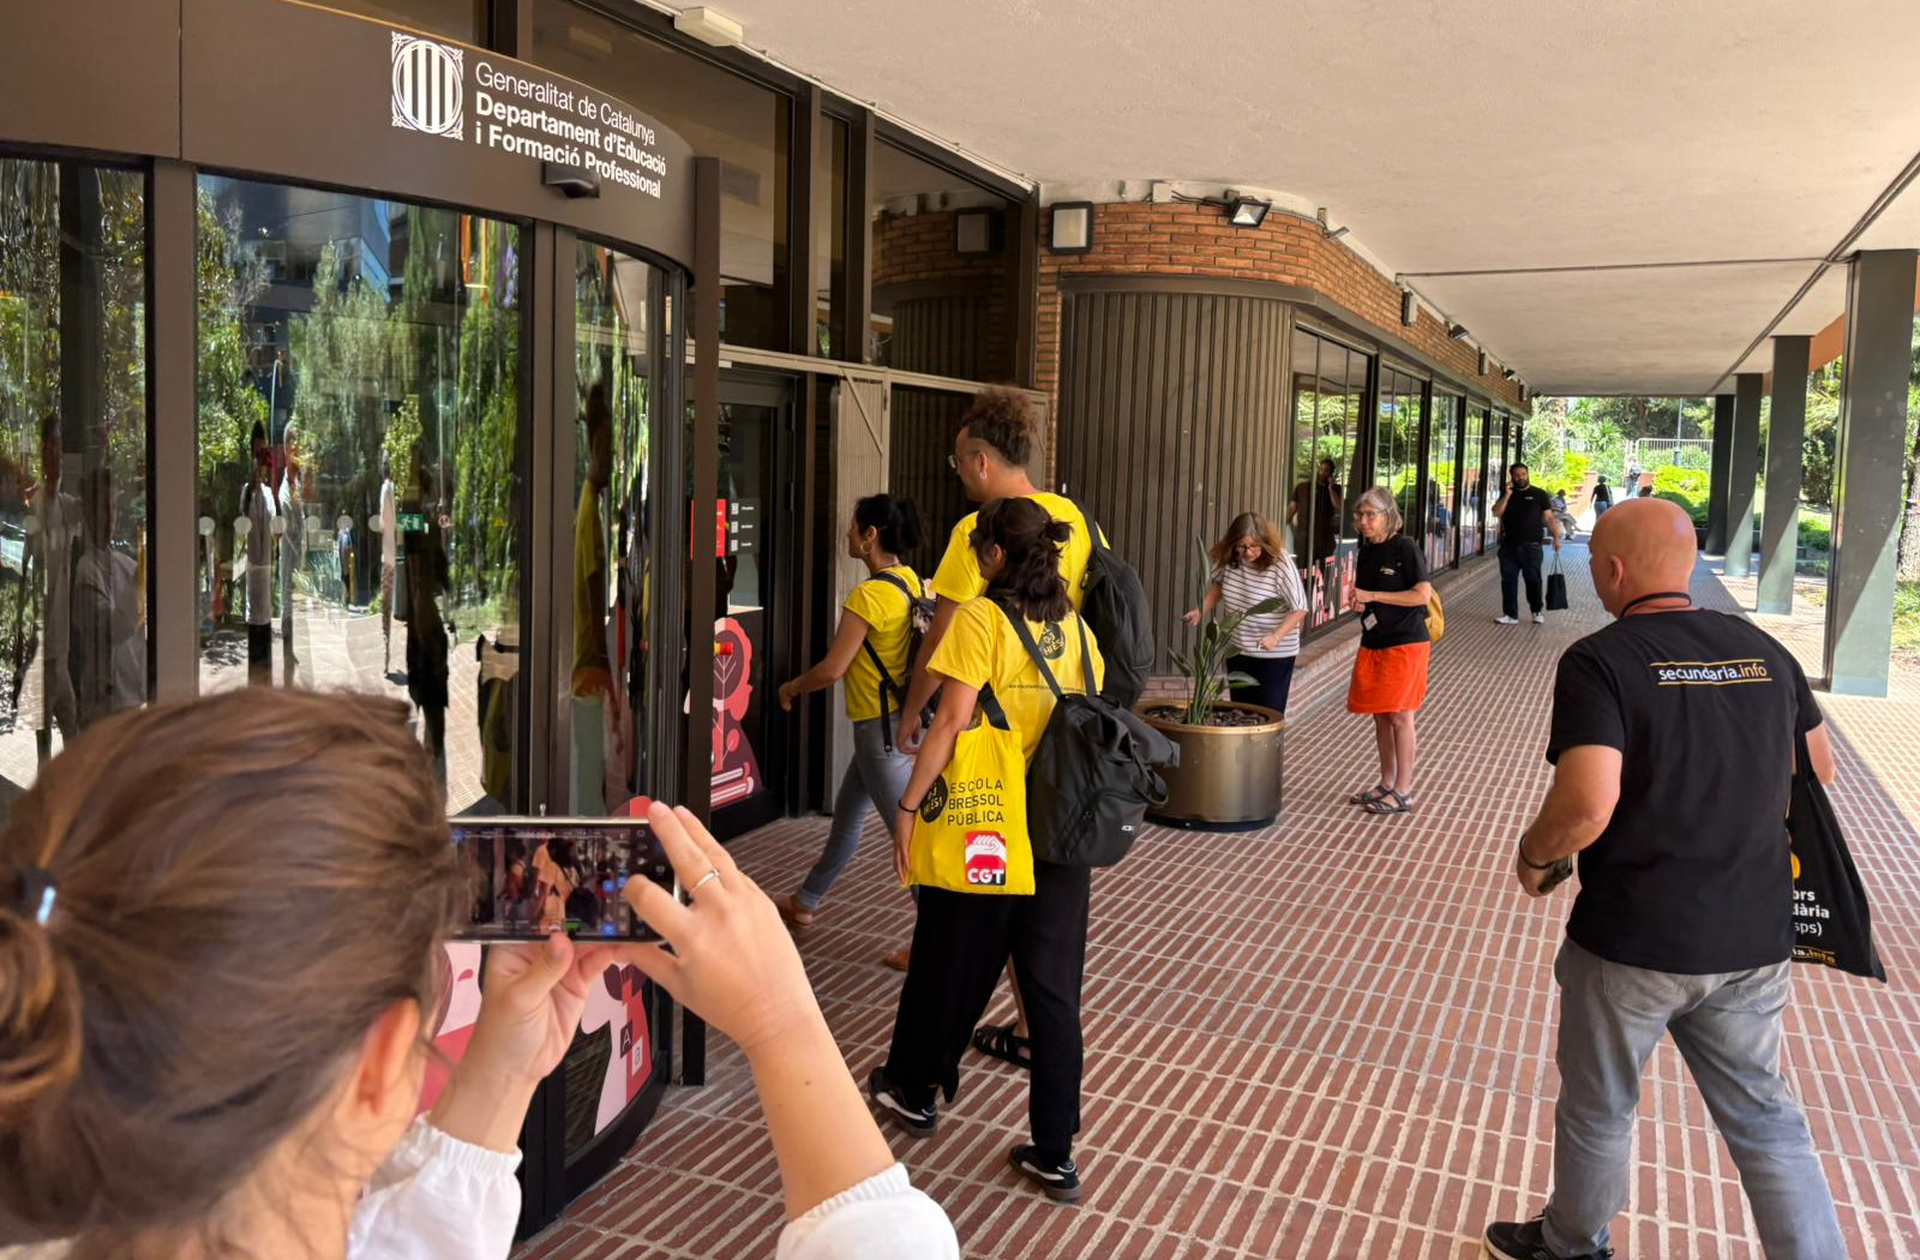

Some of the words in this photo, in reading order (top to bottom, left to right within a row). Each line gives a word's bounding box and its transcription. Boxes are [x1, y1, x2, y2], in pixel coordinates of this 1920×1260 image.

[475, 61, 574, 113] Generalitat
[578, 95, 597, 120] de
[600, 102, 655, 146] Catalunya
[476, 91, 601, 149] Departament
[603, 134, 667, 177] d'Educació
[475, 120, 481, 145] i
[489, 125, 580, 167] Formació
[585, 152, 661, 199] Professional
[1659, 662, 1767, 681] secundaria.info
[950, 777, 1003, 794] ESCOLA
[948, 793, 1004, 810] BRESSOL
[947, 810, 1004, 827] PÚBLICA
[967, 867, 1005, 884] CGT
